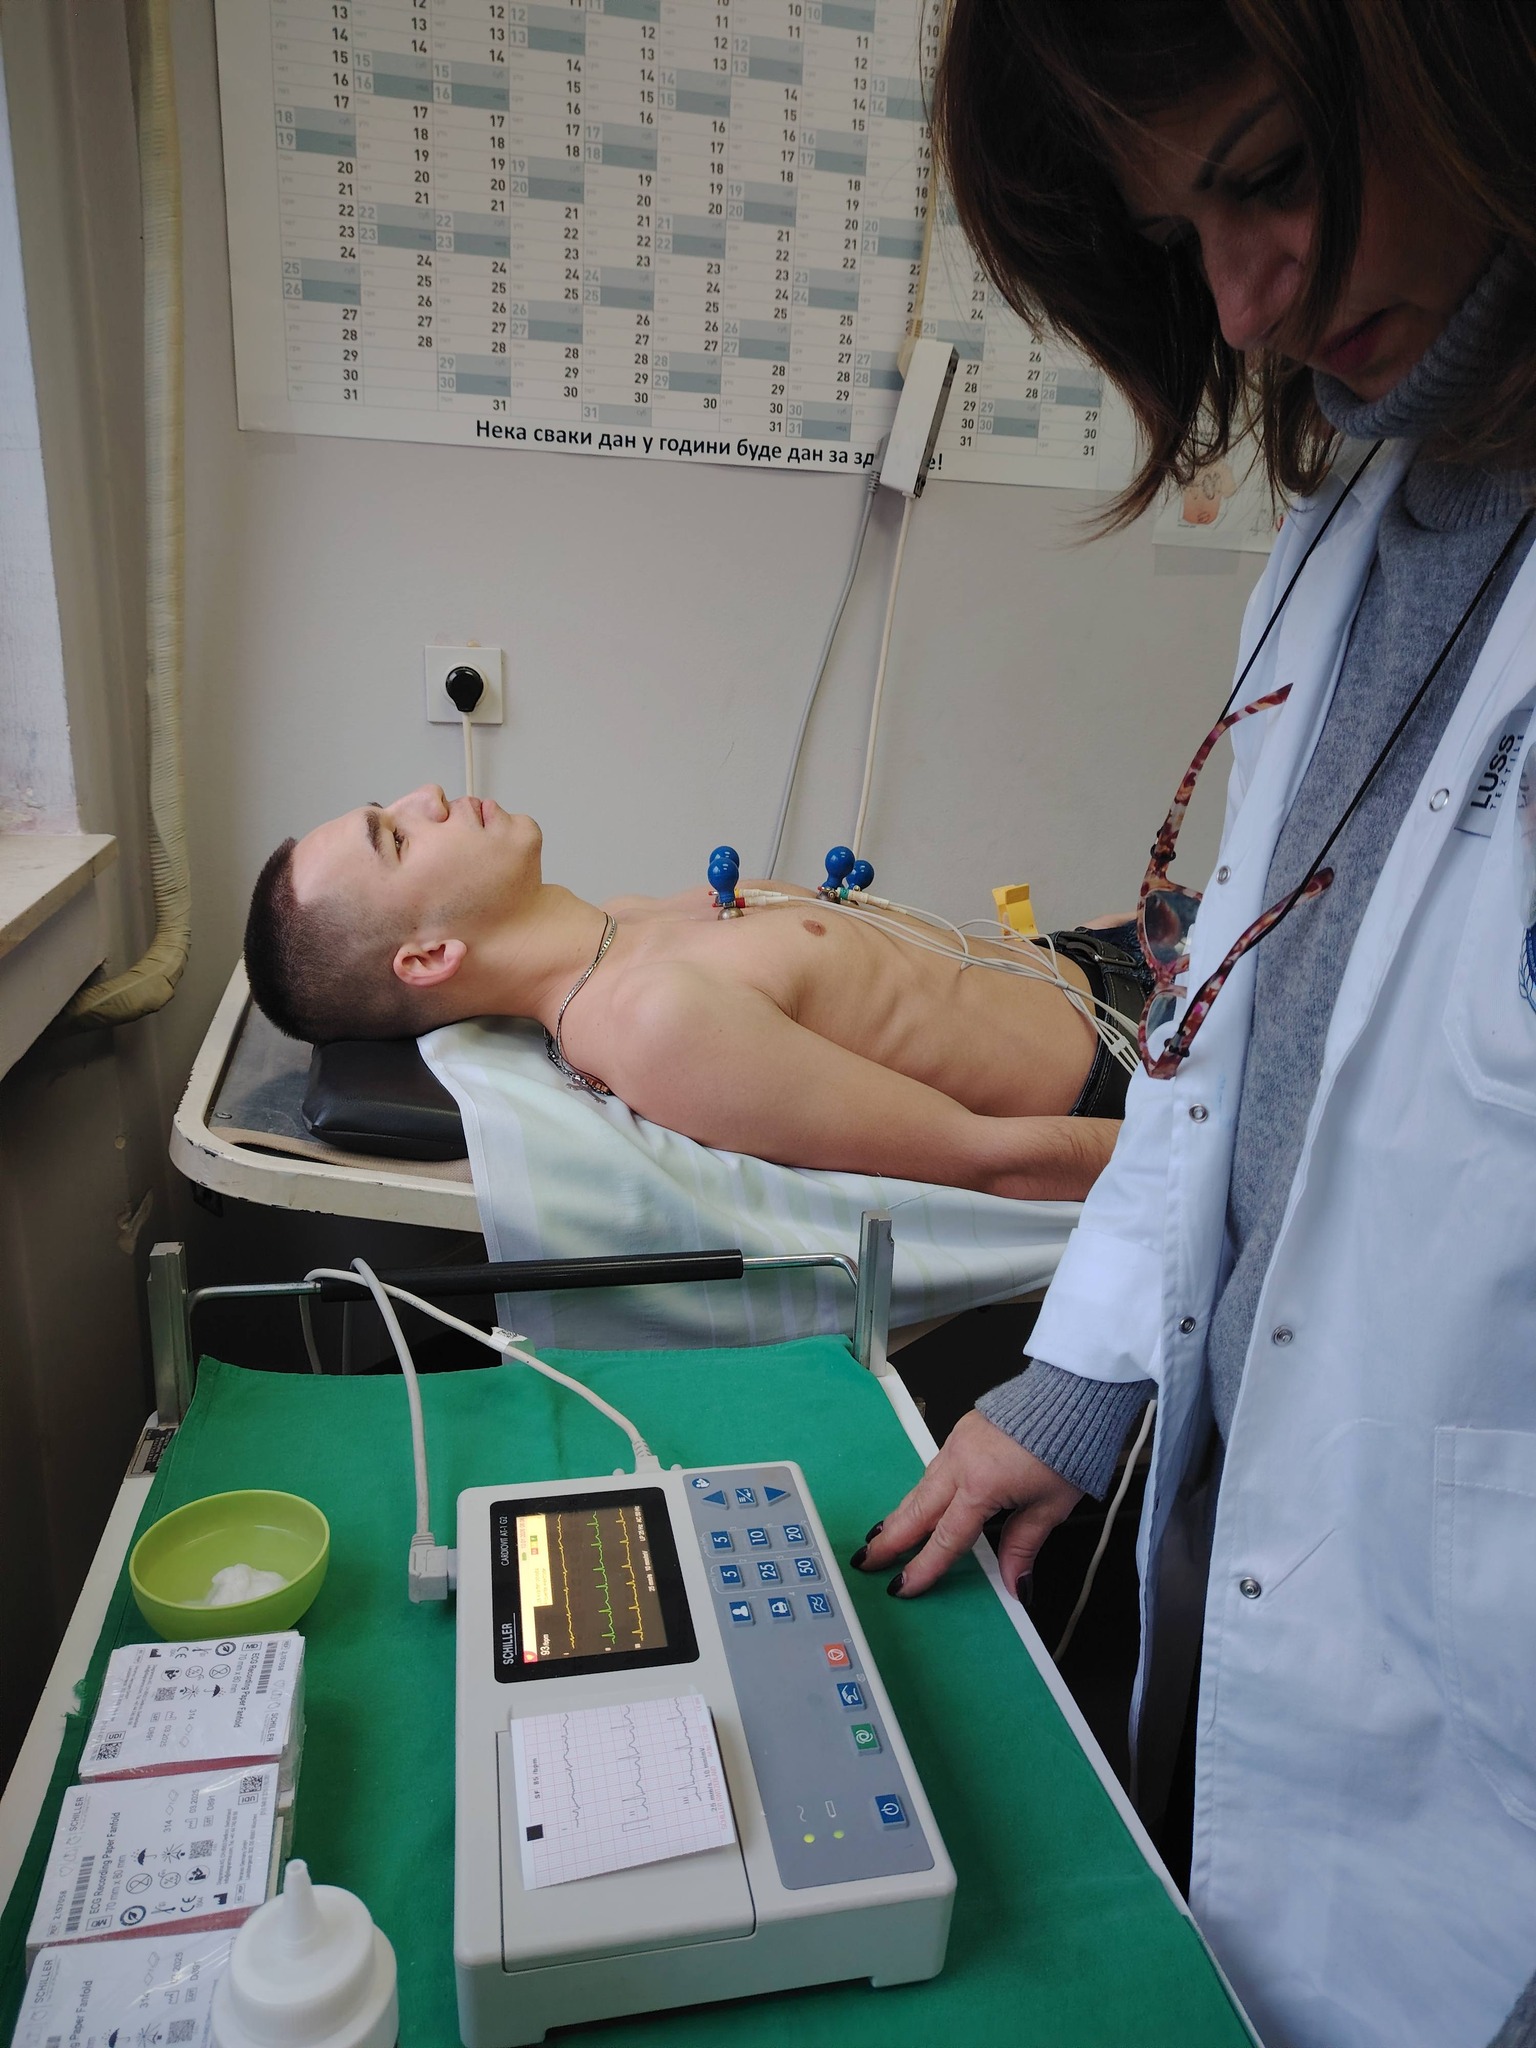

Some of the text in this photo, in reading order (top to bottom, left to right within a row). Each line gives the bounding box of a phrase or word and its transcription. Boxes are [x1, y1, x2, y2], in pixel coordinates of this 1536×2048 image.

[332, 5, 348, 19] 13
[412, 17, 427, 31] 13
[490, 27, 504, 41] 13
[642, 26, 655, 39] 12
[412, 40, 427, 53] 14
[489, 49, 504, 63] 14
[714, 58, 727, 71] 13
[641, 69, 654, 82] 14
[567, 81, 581, 93] 15
[641, 90, 654, 103] 15
[567, 102, 580, 115] 16
[277, 110, 293, 124] 18
[640, 111, 653, 124] 16
[712, 121, 725, 133] 16
[278, 132, 294, 146] 19
[783, 129, 795, 142] 16
[415, 149, 429, 162] 19
[566, 145, 580, 157] 18
[338, 161, 353, 174] 20
[415, 170, 429, 183] 20
[491, 178, 505, 191] 20
[710, 182, 723, 195] 19
[637, 194, 651, 207] 20
[847, 199, 859, 211] 19
[915, 206, 928, 218] 19
[845, 219, 858, 230] 20
[777, 230, 789, 242] 21
[340, 246, 356, 259] 24
[776, 249, 789, 262] 22
[284, 262, 300, 275] 25
[843, 257, 856, 269] 22
[565, 268, 579, 280] 24
[285, 282, 301, 295] 26
[492, 282, 506, 294] 25
[775, 289, 788, 300] 24
[492, 301, 506, 313] 26
[343, 308, 357, 321] 27
[636, 314, 650, 326] 26
[705, 321, 718, 332] 26
[635, 333, 649, 345] 27
[704, 340, 718, 351] 27
[343, 349, 358, 361] 29
[1029, 352, 1041, 363] 26
[772, 365, 785, 376] 28
[1027, 370, 1040, 381] 27
[654, 374, 669, 386] 29
[855, 372, 869, 384] 28
[771, 384, 784, 395] 29
[1026, 388, 1038, 399] 28
[703, 398, 717, 409] 30
[789, 404, 802, 416] 30
[963, 400, 976, 412] 29
[980, 401, 994, 413] 29
[584, 406, 597, 418] 31
[961, 418, 974, 429] 30
[980, 419, 992, 431] 30
[477, 420, 942, 470] Нека сваки дан у години буде дан за зде!
[960, 436, 971, 447] 31
[1470, 734, 1514, 809] LUSS
[500, 1526, 508, 1536] AT-1
[751, 1531, 765, 1542] 10
[788, 1527, 801, 1539] 20
[500, 1538, 509, 1565] CARDIOVIT
[761, 1564, 774, 1577] 25
[798, 1560, 812, 1573] 50
[502, 1623, 514, 1664] SCHILLER
[542, 1646, 550, 1656] 93
[236, 1661, 245, 1671] mm
[230, 1684, 238, 1693] mm
[233, 1653, 260, 1728] ECG Recording Paper Fanfold
[187, 1709, 197, 1720] 314
[267, 1713, 279, 1742] SCHILLER
[699, 1747, 709, 1768] mm/mV
[532, 1758, 541, 1799] SF 85 /bpm
[704, 1770, 711, 1778] 10
[189, 1789, 199, 1813] 03.2025
[206, 1795, 216, 1810] D891
[709, 1765, 727, 1830] SCHILLER SWITZERLAND
[68, 1796, 84, 1832] SCHILLER
[711, 1803, 717, 1812] 25
[163, 1819, 173, 1832] 314
[89, 1812, 120, 1914] ECG Recording Paper Fanfold
[117, 1855, 127, 1868] mm
[114, 1869, 124, 1879] 80
[109, 1887, 119, 1900] mm
[53, 1890, 67, 1921] 2.157058
[105, 1902, 116, 1911] 70
[34, 1959, 54, 2004] SCHILLER
[75, 1980, 93, 2013] Fanfold
[69, 2015, 86, 2040] Paper
